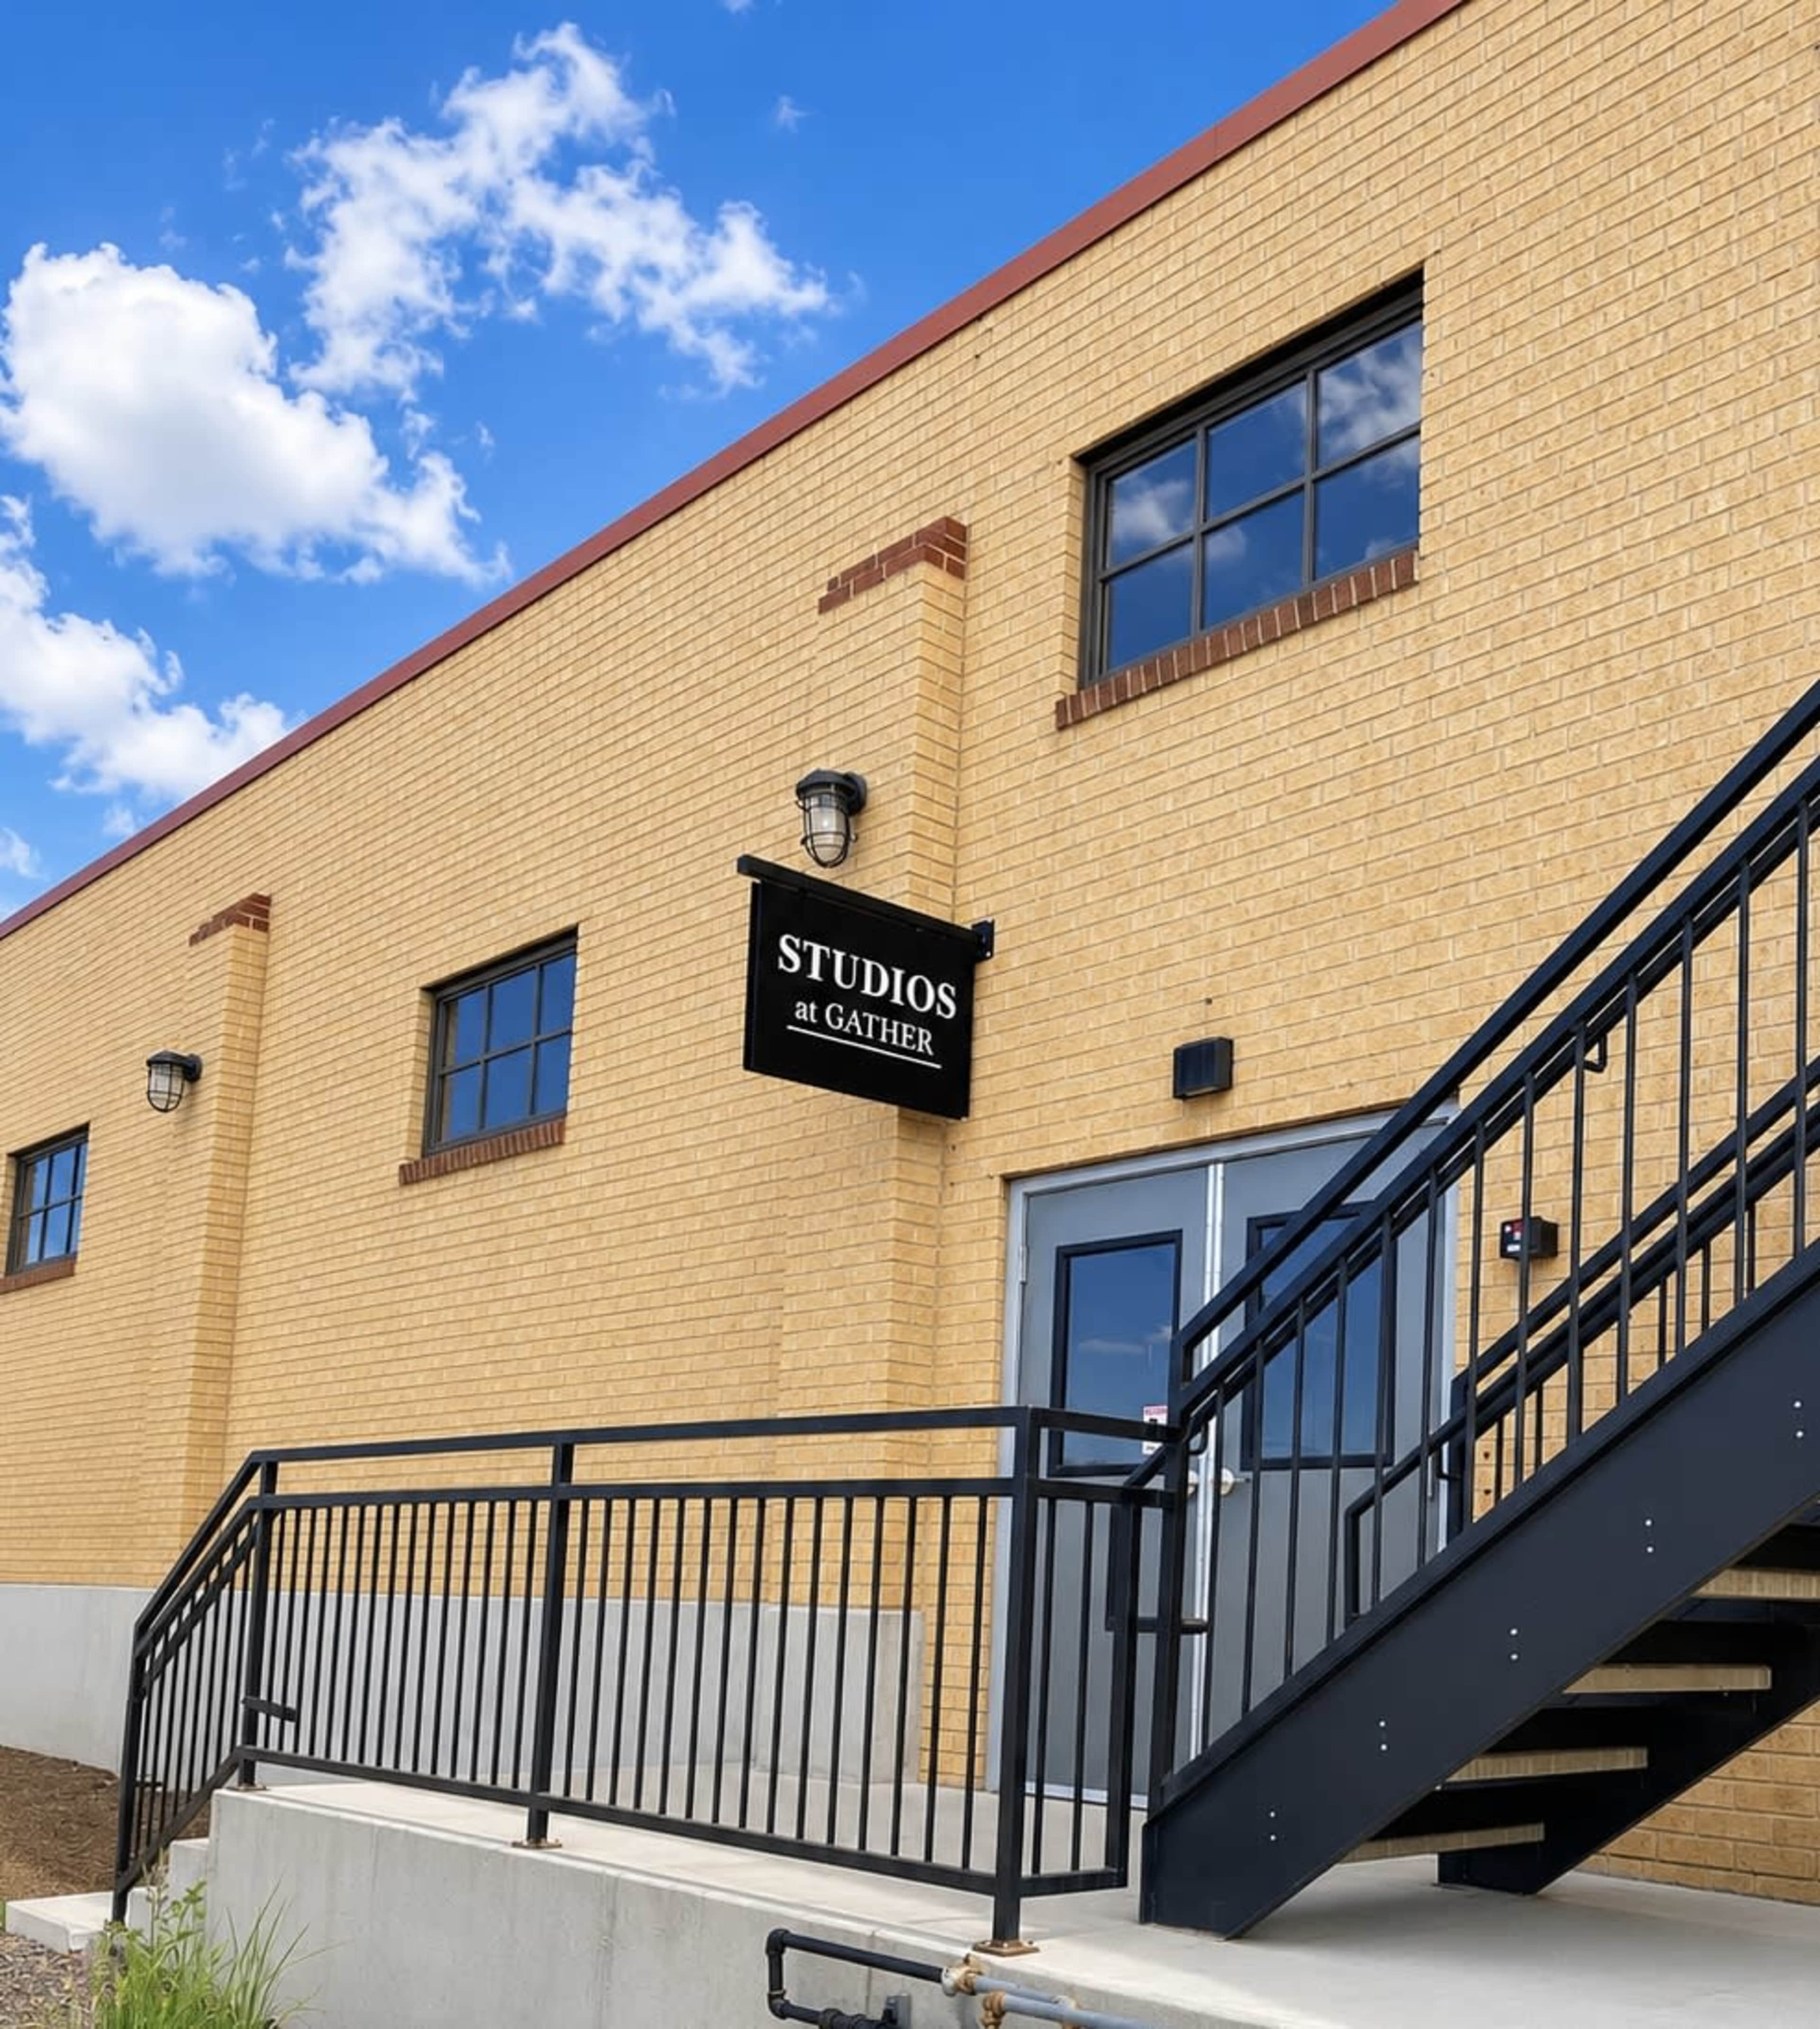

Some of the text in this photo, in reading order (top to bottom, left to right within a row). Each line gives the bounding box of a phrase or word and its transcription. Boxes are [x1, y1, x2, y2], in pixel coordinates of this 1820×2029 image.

[778, 933, 956, 1019] STUDIOS
[794, 1001, 934, 1055] at GATHER
